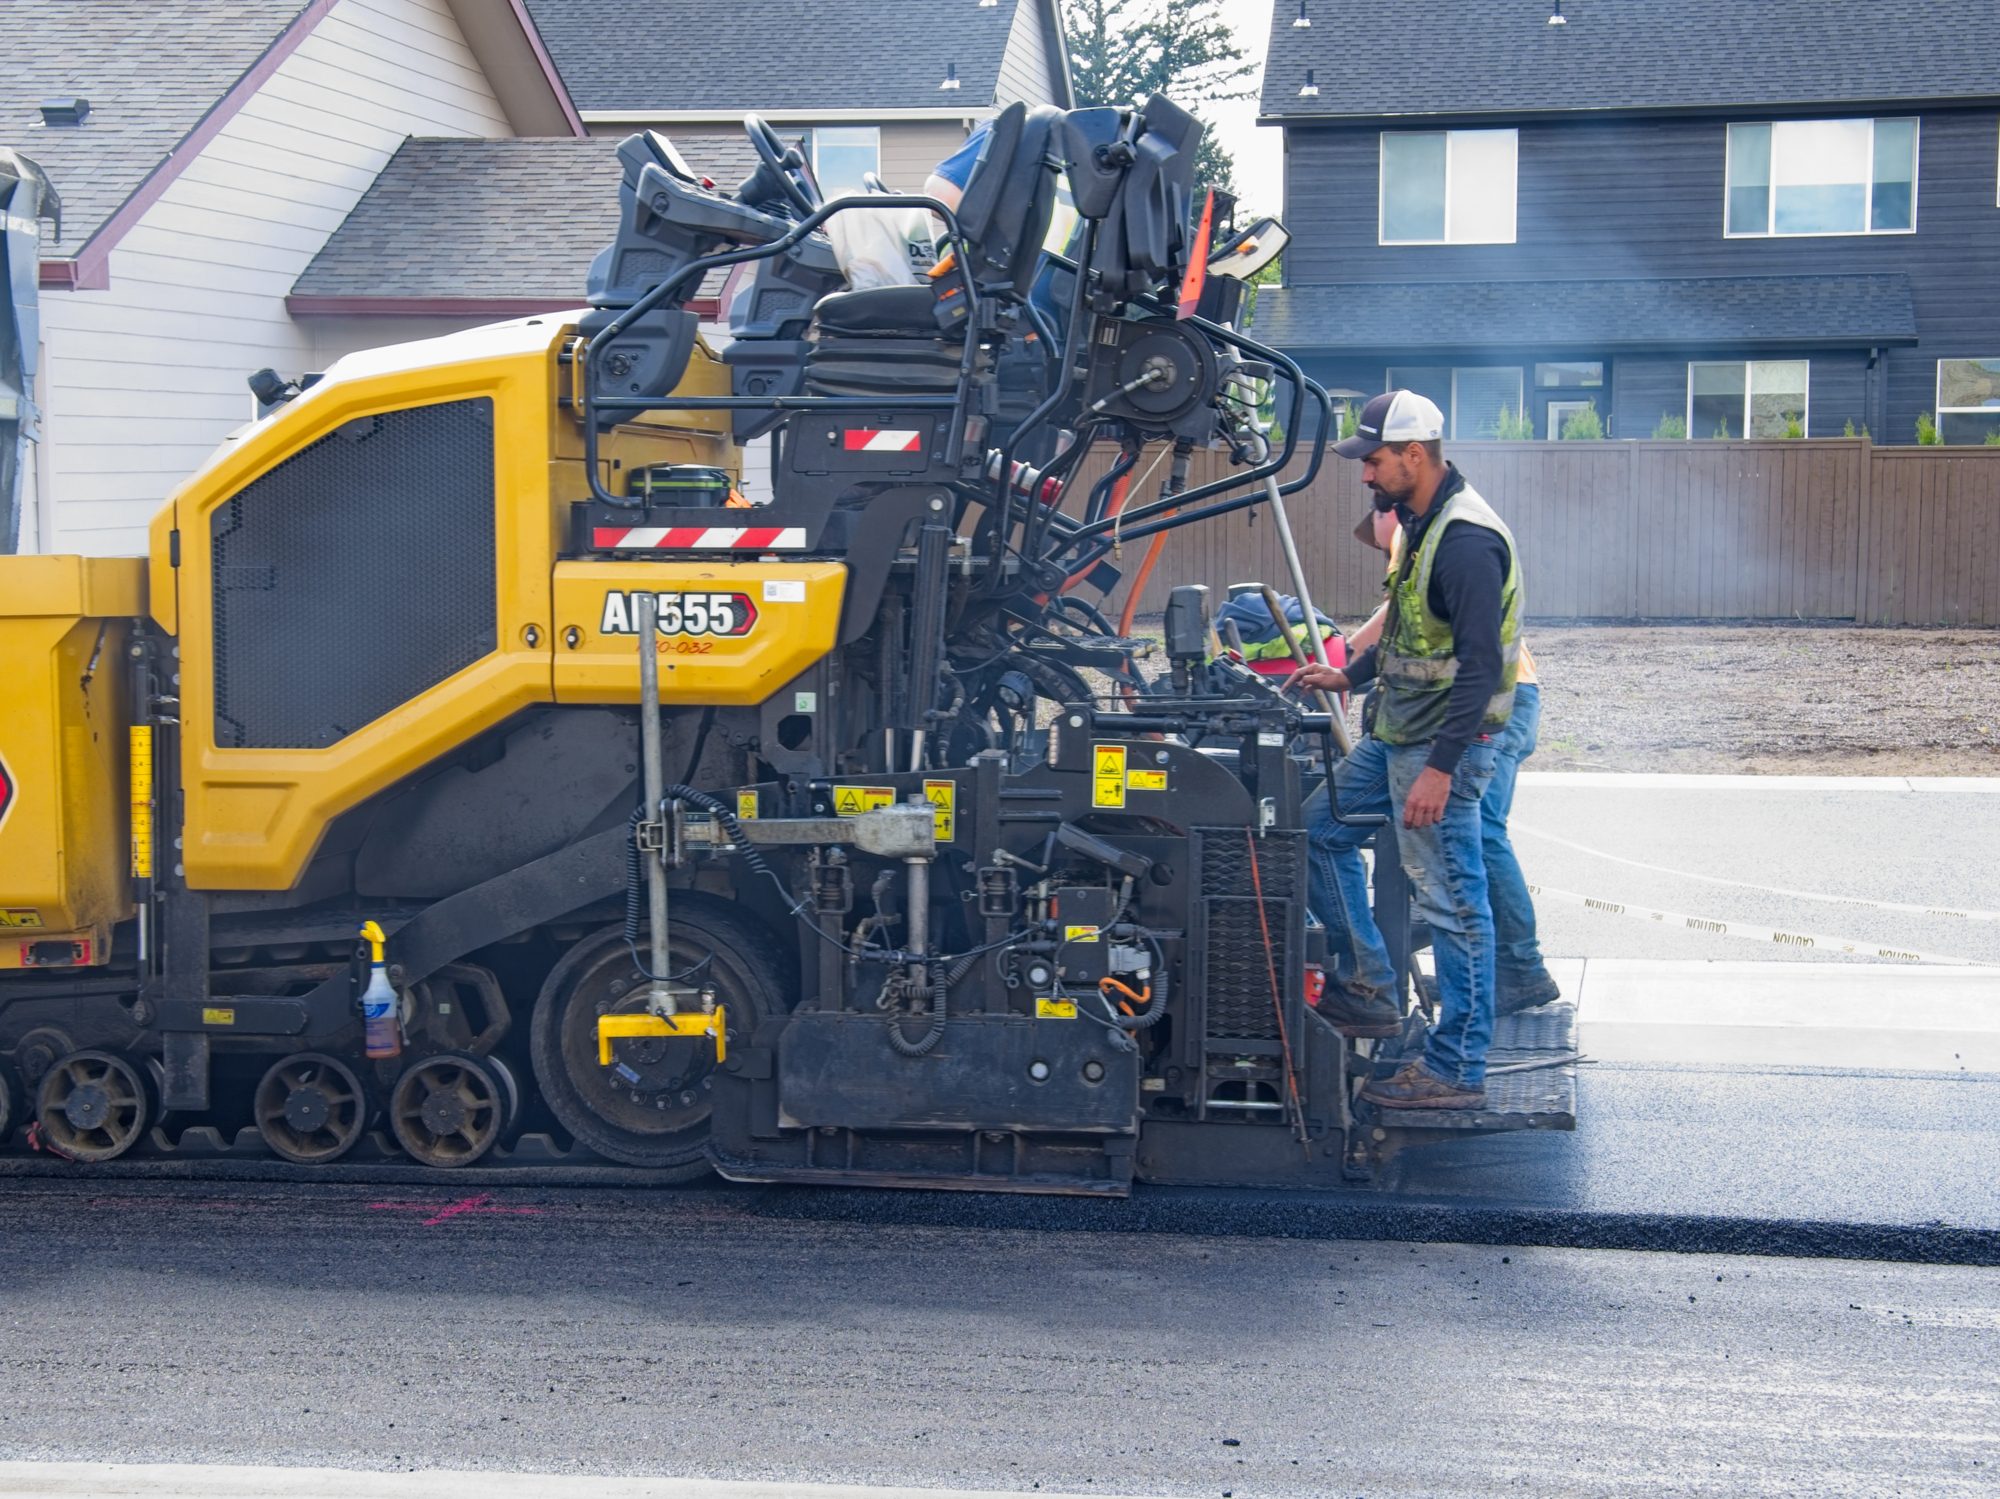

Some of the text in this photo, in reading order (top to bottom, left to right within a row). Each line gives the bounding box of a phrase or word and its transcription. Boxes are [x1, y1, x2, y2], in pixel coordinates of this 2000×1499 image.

[636, 641, 714, 654] 0-032
[1584, 898, 1920, 961] CAUTION CAUTION CAUTION CAUTION
